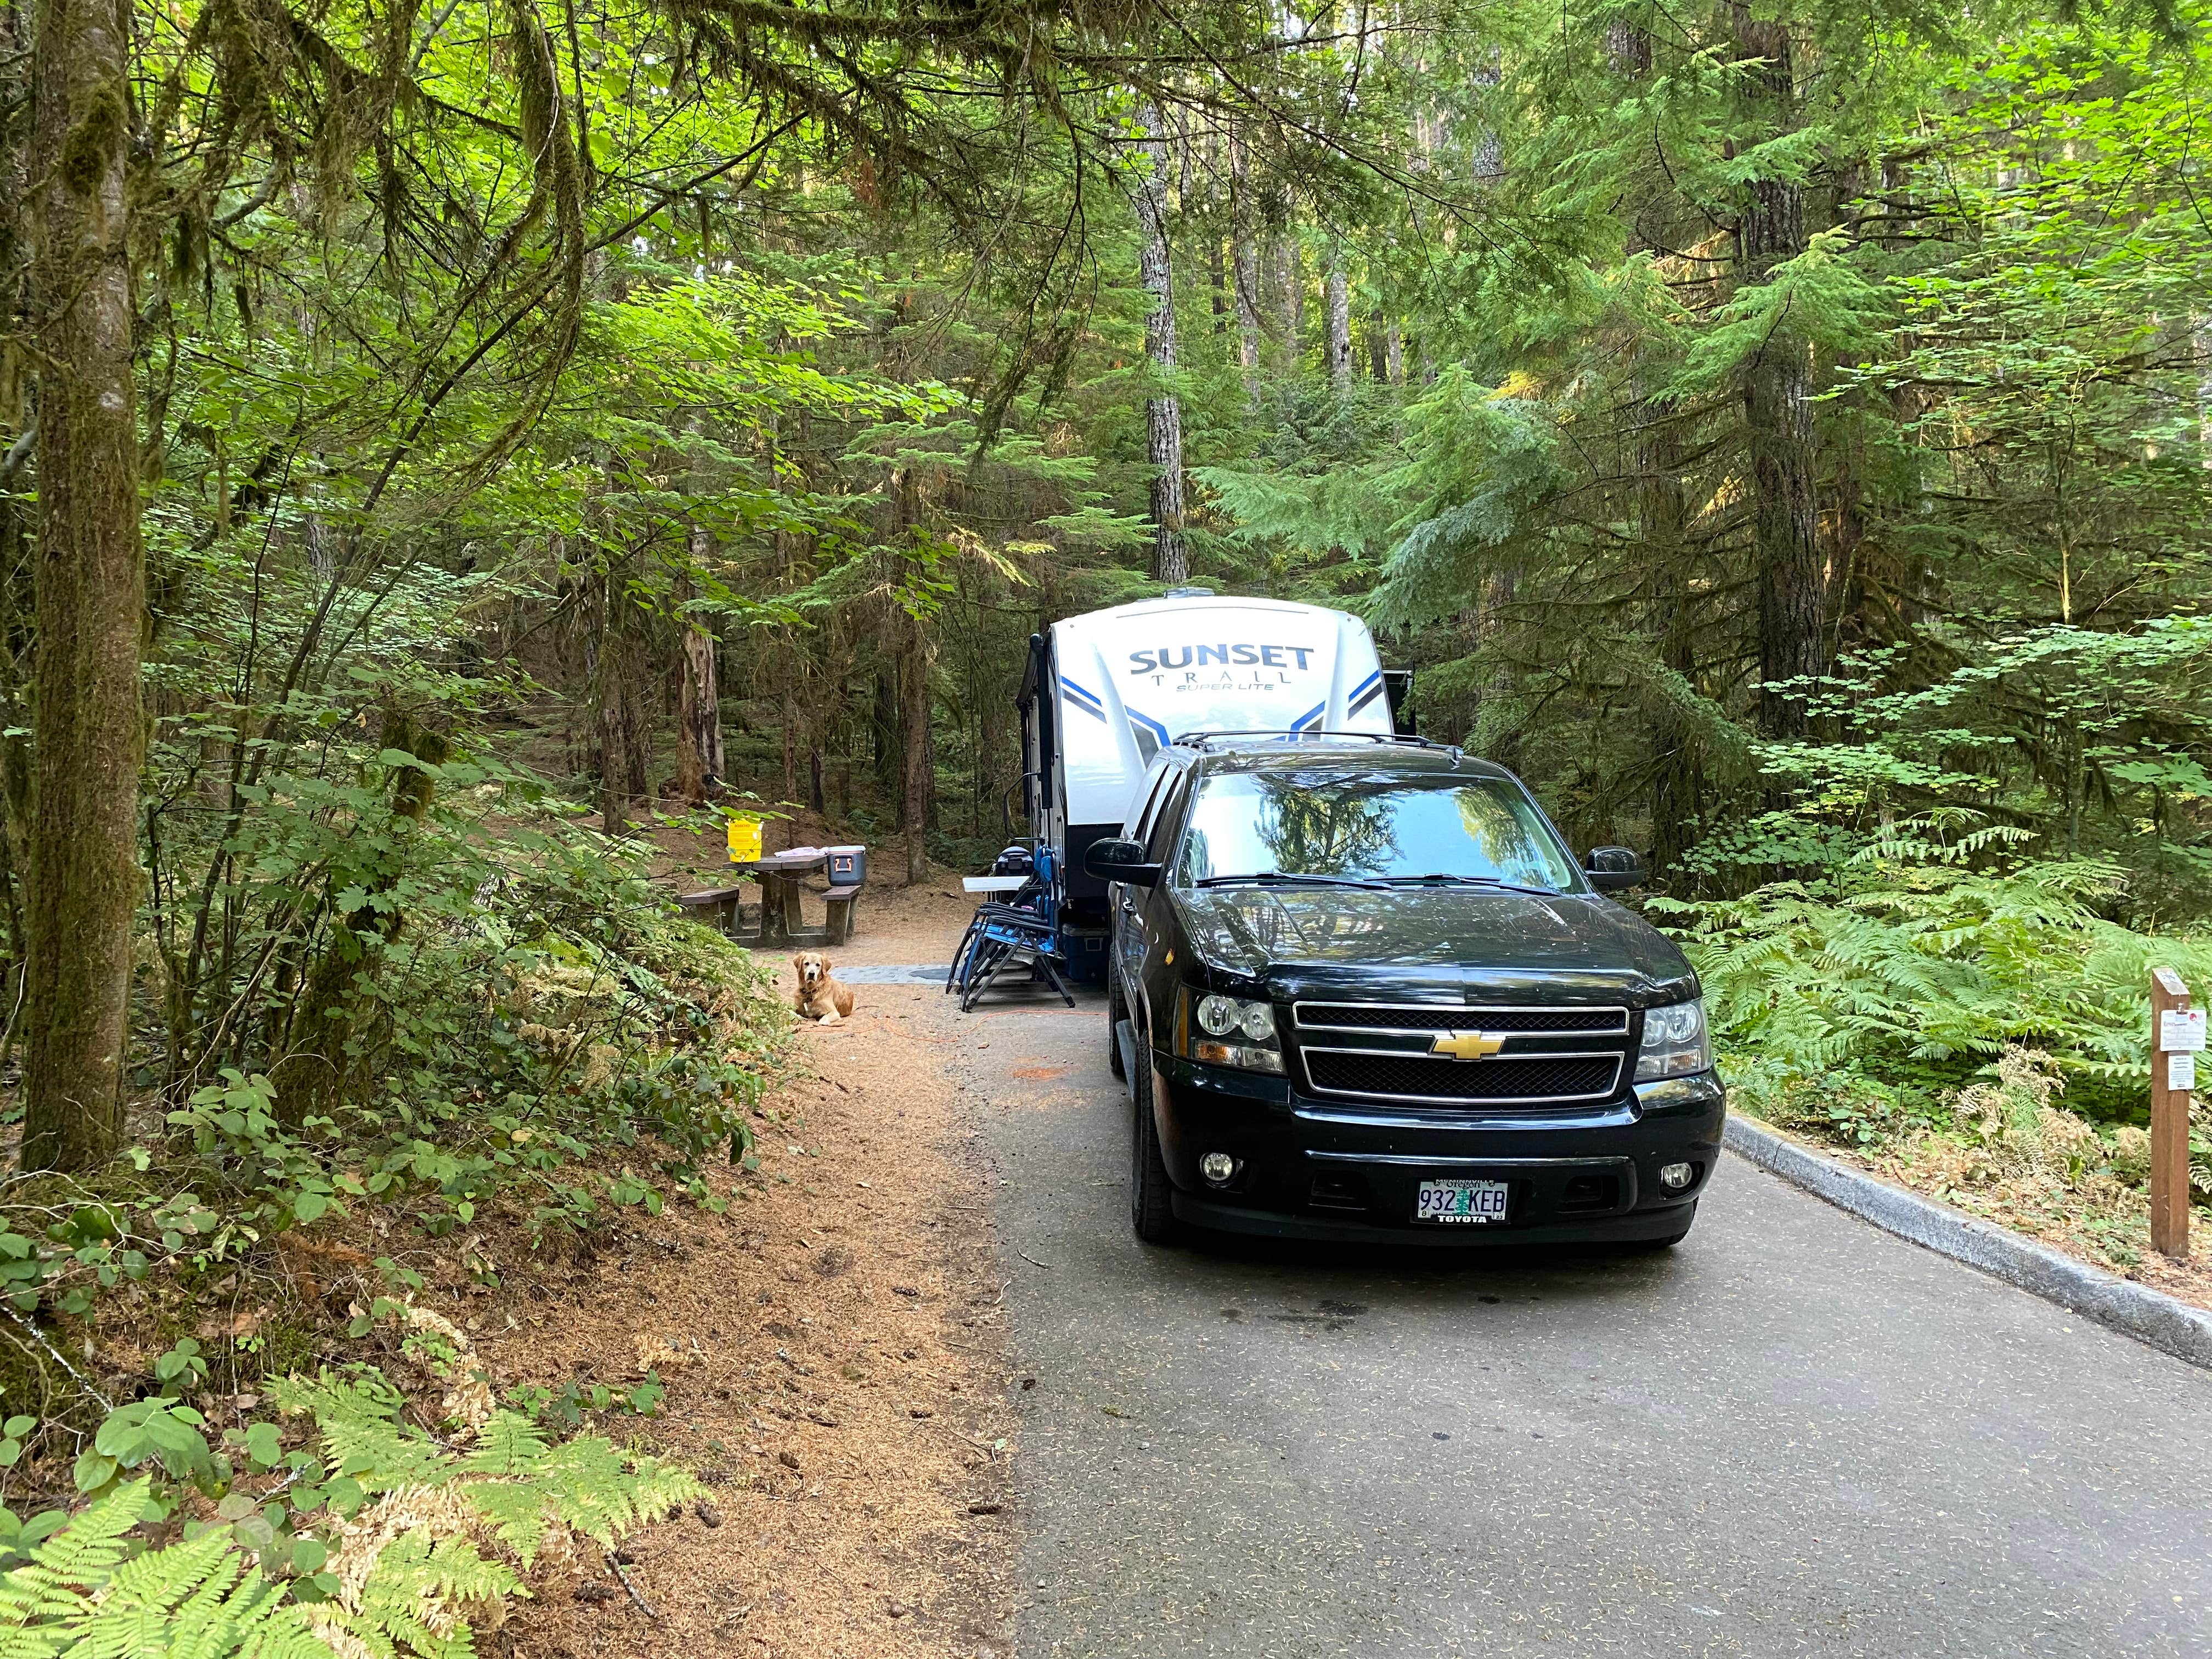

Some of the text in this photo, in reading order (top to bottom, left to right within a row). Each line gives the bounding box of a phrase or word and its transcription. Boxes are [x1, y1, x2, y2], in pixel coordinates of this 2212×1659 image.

[1129, 644, 1314, 675] SUNSET
[1151, 670, 1291, 686] TRAIL
[1176, 684, 1233, 692] SUPER
[1446, 1181, 1481, 1189] Oregon
[1420, 1189, 1505, 1212] 932 KEB
